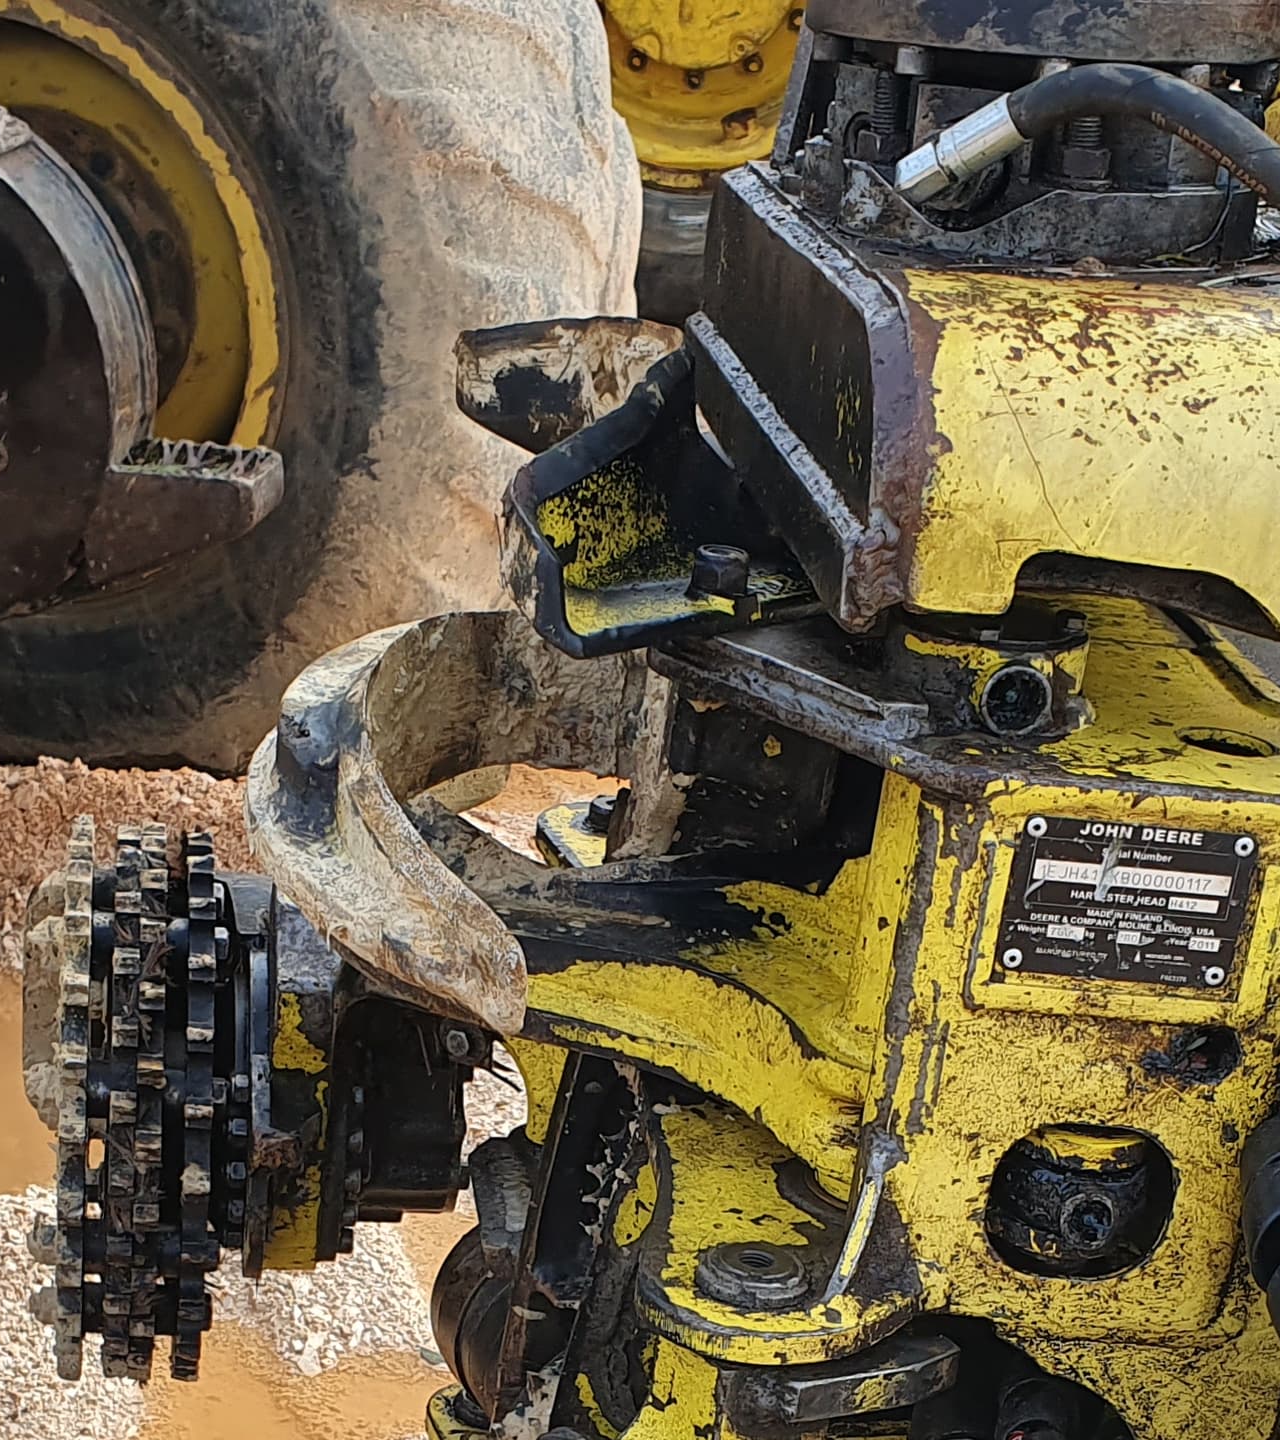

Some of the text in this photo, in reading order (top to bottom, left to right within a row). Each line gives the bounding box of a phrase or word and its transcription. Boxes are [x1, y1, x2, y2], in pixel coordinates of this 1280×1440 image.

[1079, 822, 1205, 846] JOHN DEERE
[1102, 847, 1173, 863] Sial Number
[1039, 863, 1212, 892] 1EJH41XB00000117
[1137, 895, 1167, 907] HEAD
[1086, 908, 1113, 918] MADE
[1124, 912, 1163, 922] FINLAND
[1030, 913, 1061, 922] DEERE
[1062, 915, 1068, 923] &
[1070, 916, 1116, 928] COMPANY,
[1196, 927, 1215, 936] USA
[1190, 938, 1215, 949] 2011
